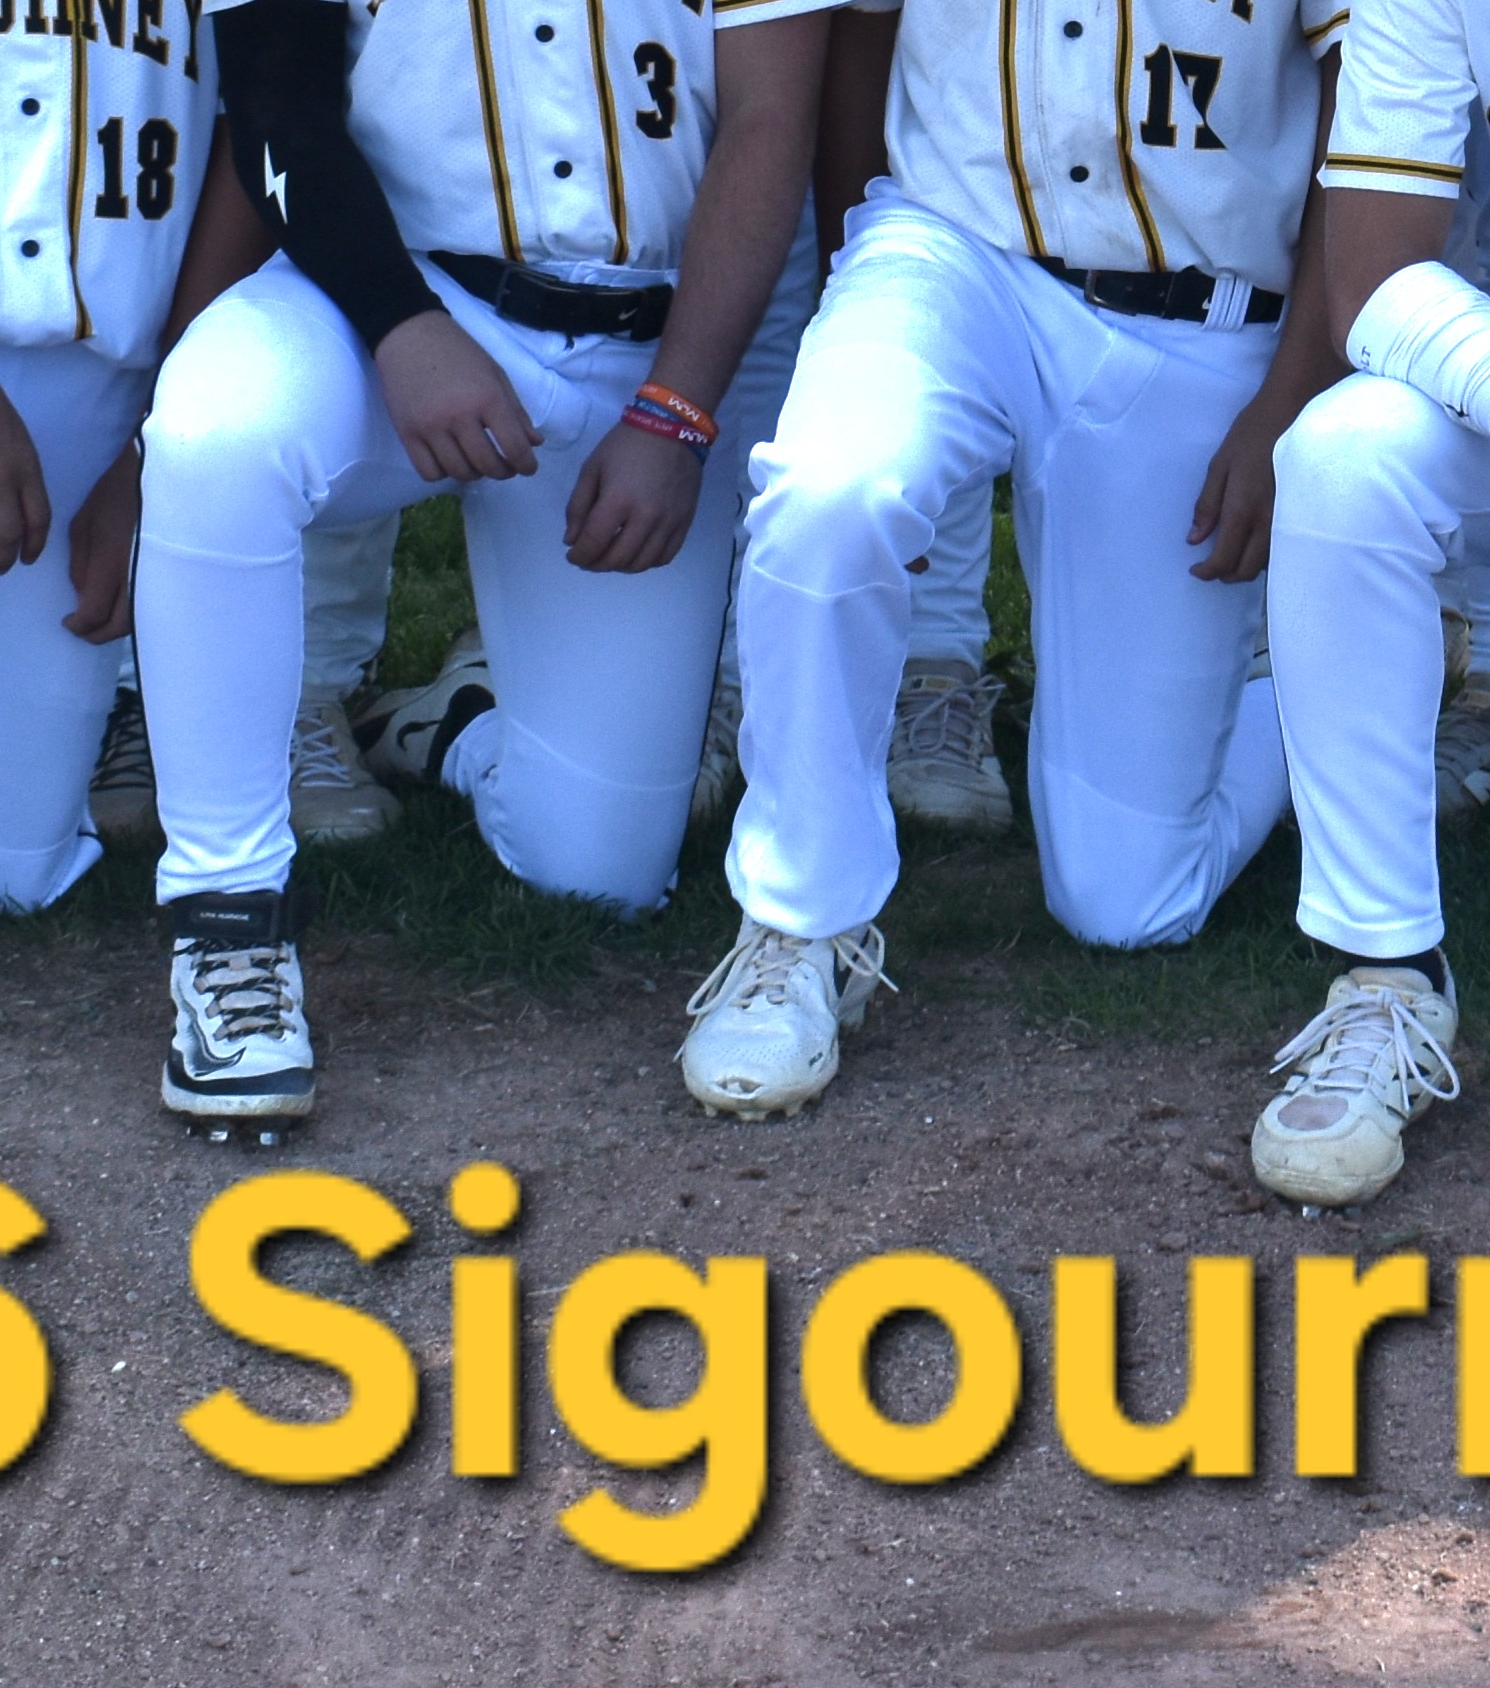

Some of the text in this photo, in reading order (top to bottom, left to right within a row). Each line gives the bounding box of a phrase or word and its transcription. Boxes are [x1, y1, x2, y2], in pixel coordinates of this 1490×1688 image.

[633, 40, 677, 140] 3
[1140, 42, 1229, 152] 17
[94, 116, 179, 221] 18
